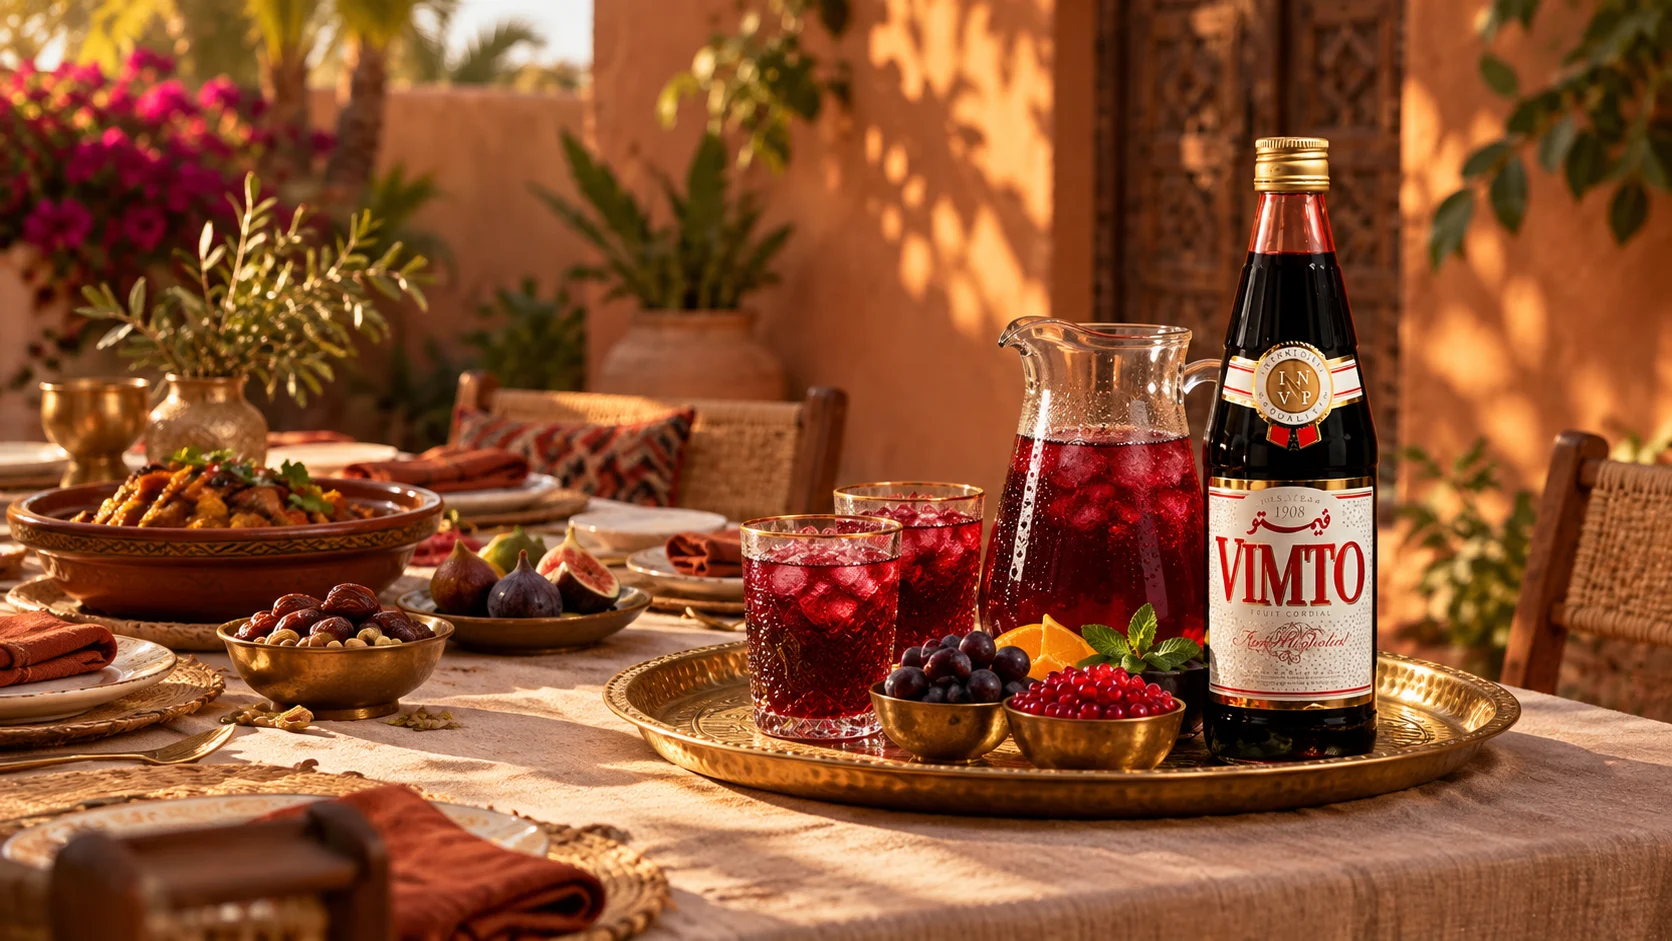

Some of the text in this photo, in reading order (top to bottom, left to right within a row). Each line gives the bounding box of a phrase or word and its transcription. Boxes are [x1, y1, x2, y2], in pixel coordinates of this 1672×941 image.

[1275, 506, 1305, 520] 1908
[1215, 535, 1365, 606] VIMTO
[1285, 610, 1331, 618] CORDIAL
